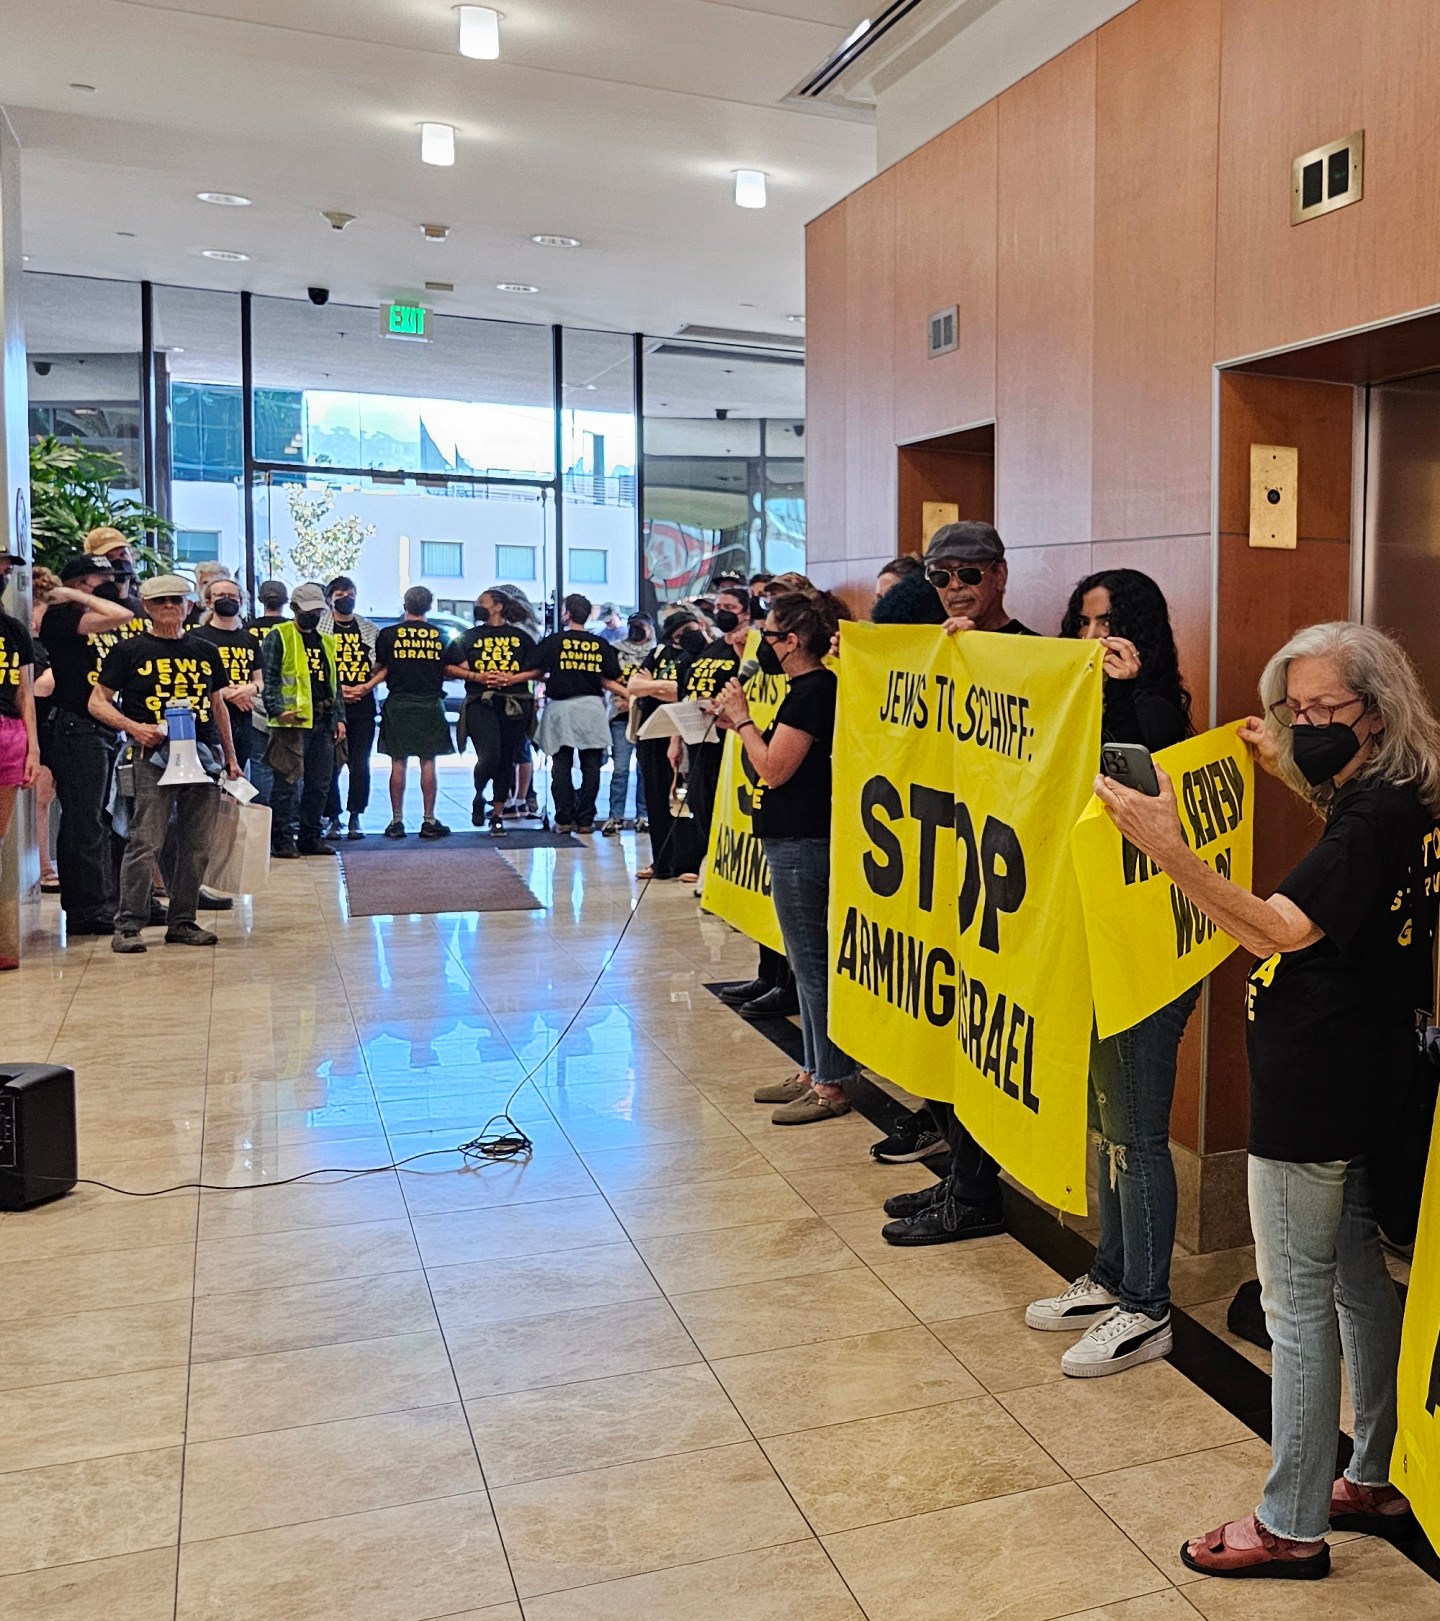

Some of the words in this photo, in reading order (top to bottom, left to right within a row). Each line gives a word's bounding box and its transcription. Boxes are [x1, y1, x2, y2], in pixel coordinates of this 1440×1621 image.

[389, 304, 426, 335] EXIT
[397, 627, 439, 639] STOP
[393, 639, 443, 650] ARMING
[473, 636, 521, 648] JEWS
[562, 638, 600, 652] STOP
[218, 646, 254, 662] EWS
[393, 649, 441, 661] ISRAEL
[481, 651, 514, 661] LET
[560, 650, 603, 662] ARMING
[137, 658, 212, 676] JEWS
[337, 662, 371, 673] AZA
[474, 659, 520, 672] GAZA
[559, 660, 602, 673] ISRAEL
[690, 657, 736, 671] JEWS
[159, 672, 201, 685] SAY
[230, 668, 250, 681] ET
[340, 671, 367, 682] IVE
[692, 667, 718, 678] SAY
[155, 683, 207, 698] LET
[686, 677, 717, 692] LET
[154, 710, 210, 724] LE
[880, 670, 929, 729] JEWS
[957, 684, 1035, 763] SCHIFF:
[861, 774, 1027, 954] STOP
[836, 906, 956, 1028] ARMING
[957, 960, 1040, 1115] ISRAEL
